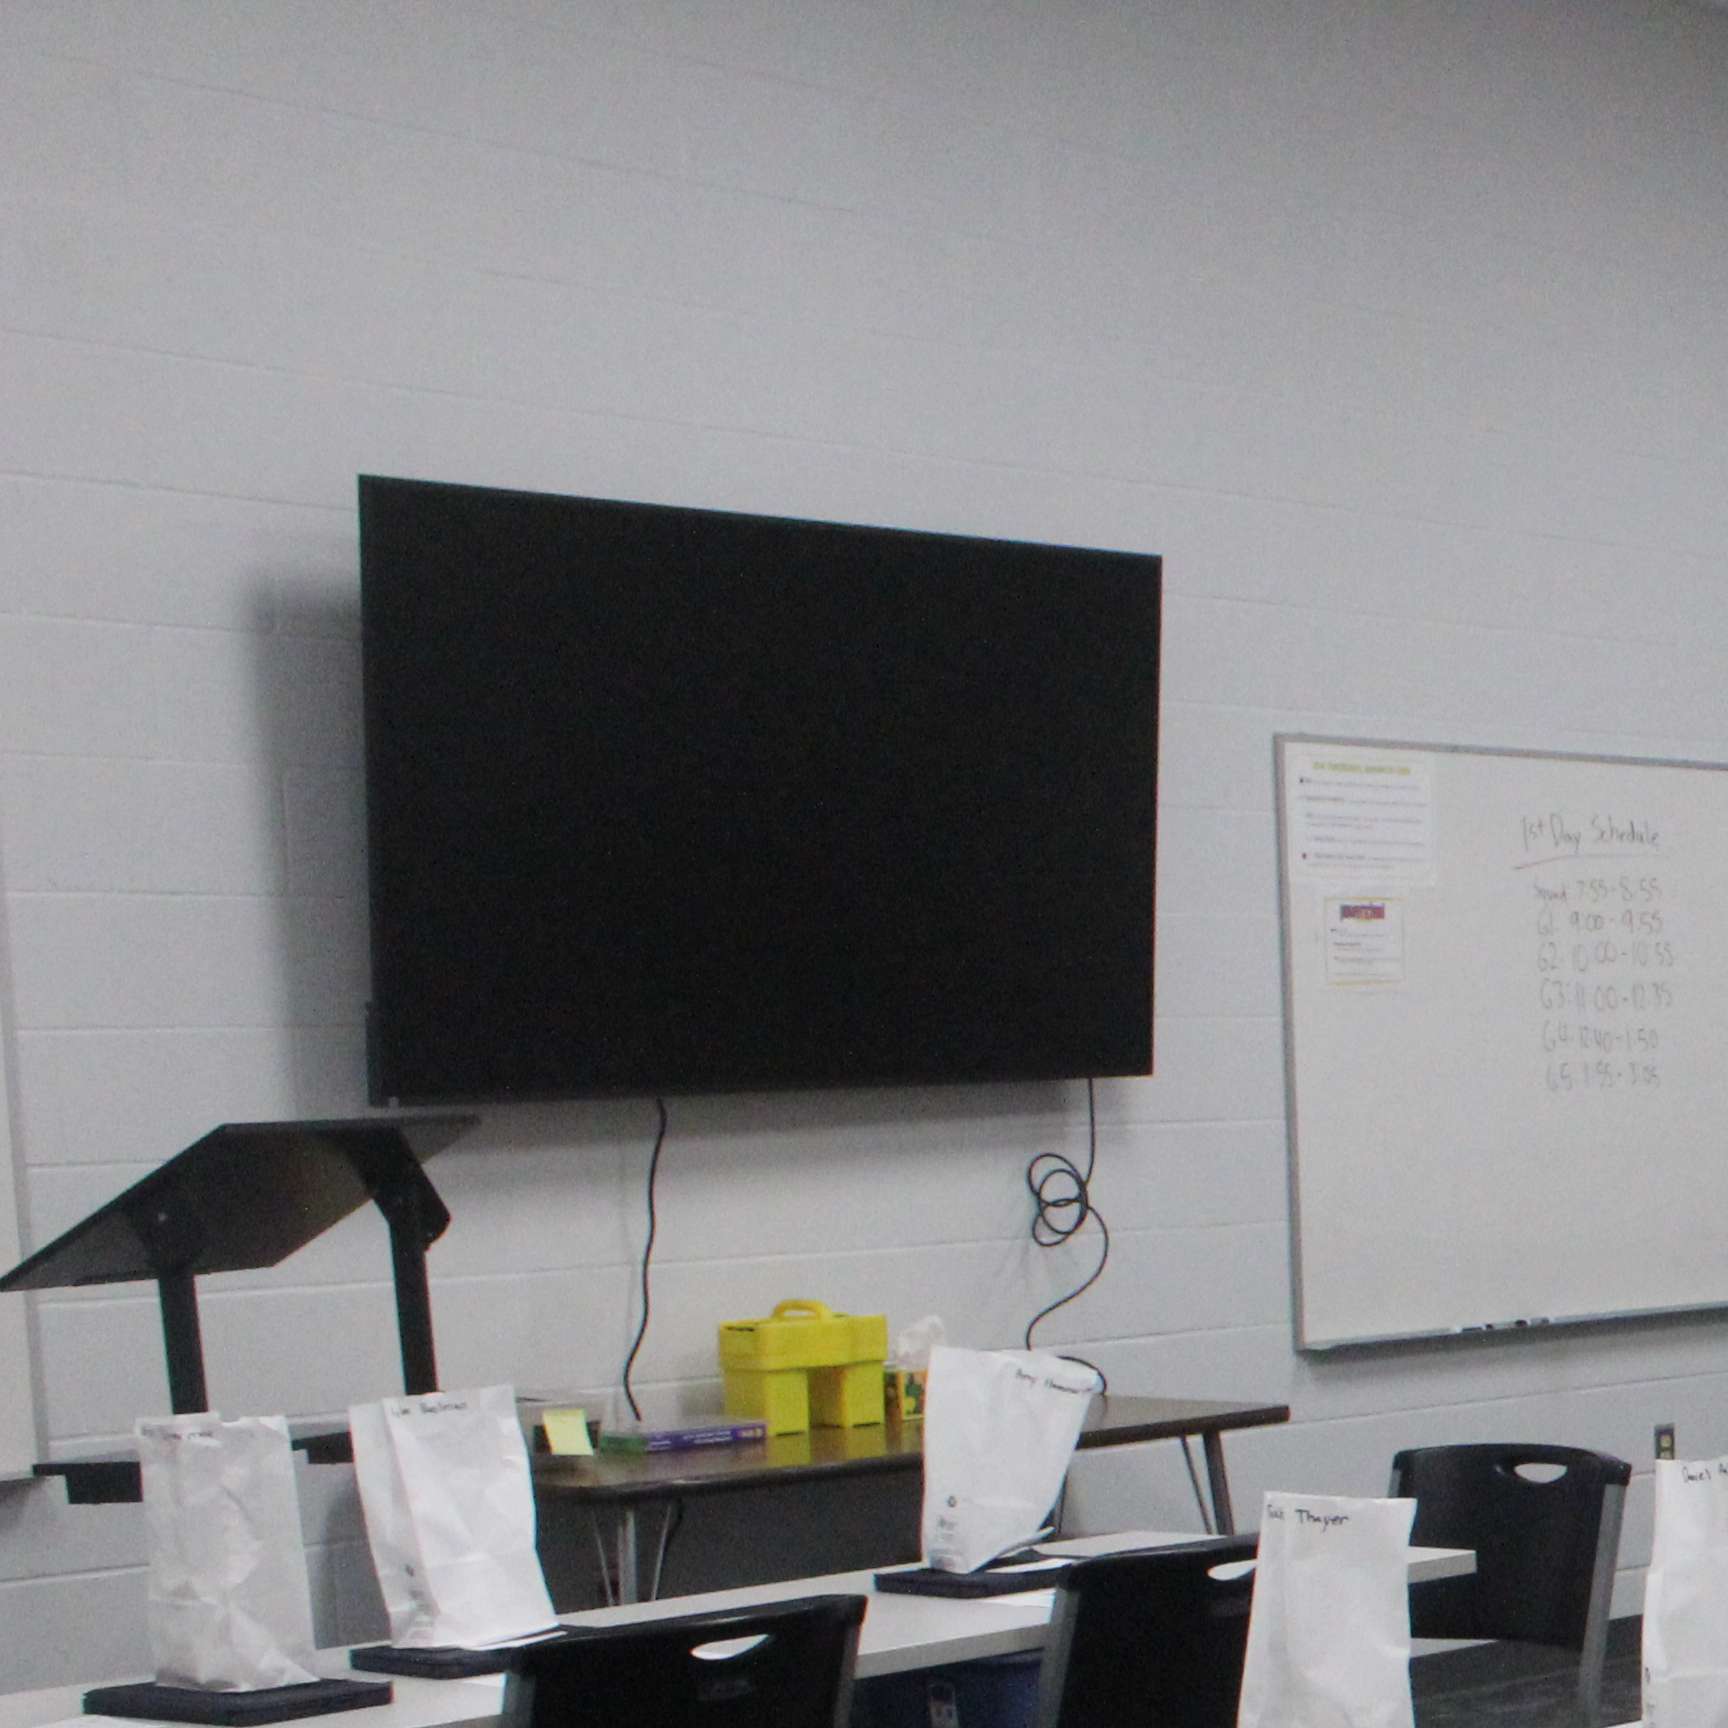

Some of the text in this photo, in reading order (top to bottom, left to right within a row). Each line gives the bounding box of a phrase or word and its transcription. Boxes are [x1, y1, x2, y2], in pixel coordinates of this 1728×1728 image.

[1550, 813, 1582, 854] Day
[1591, 814, 1660, 847] Schedule
[1294, 1508, 1349, 1533] Thayer
